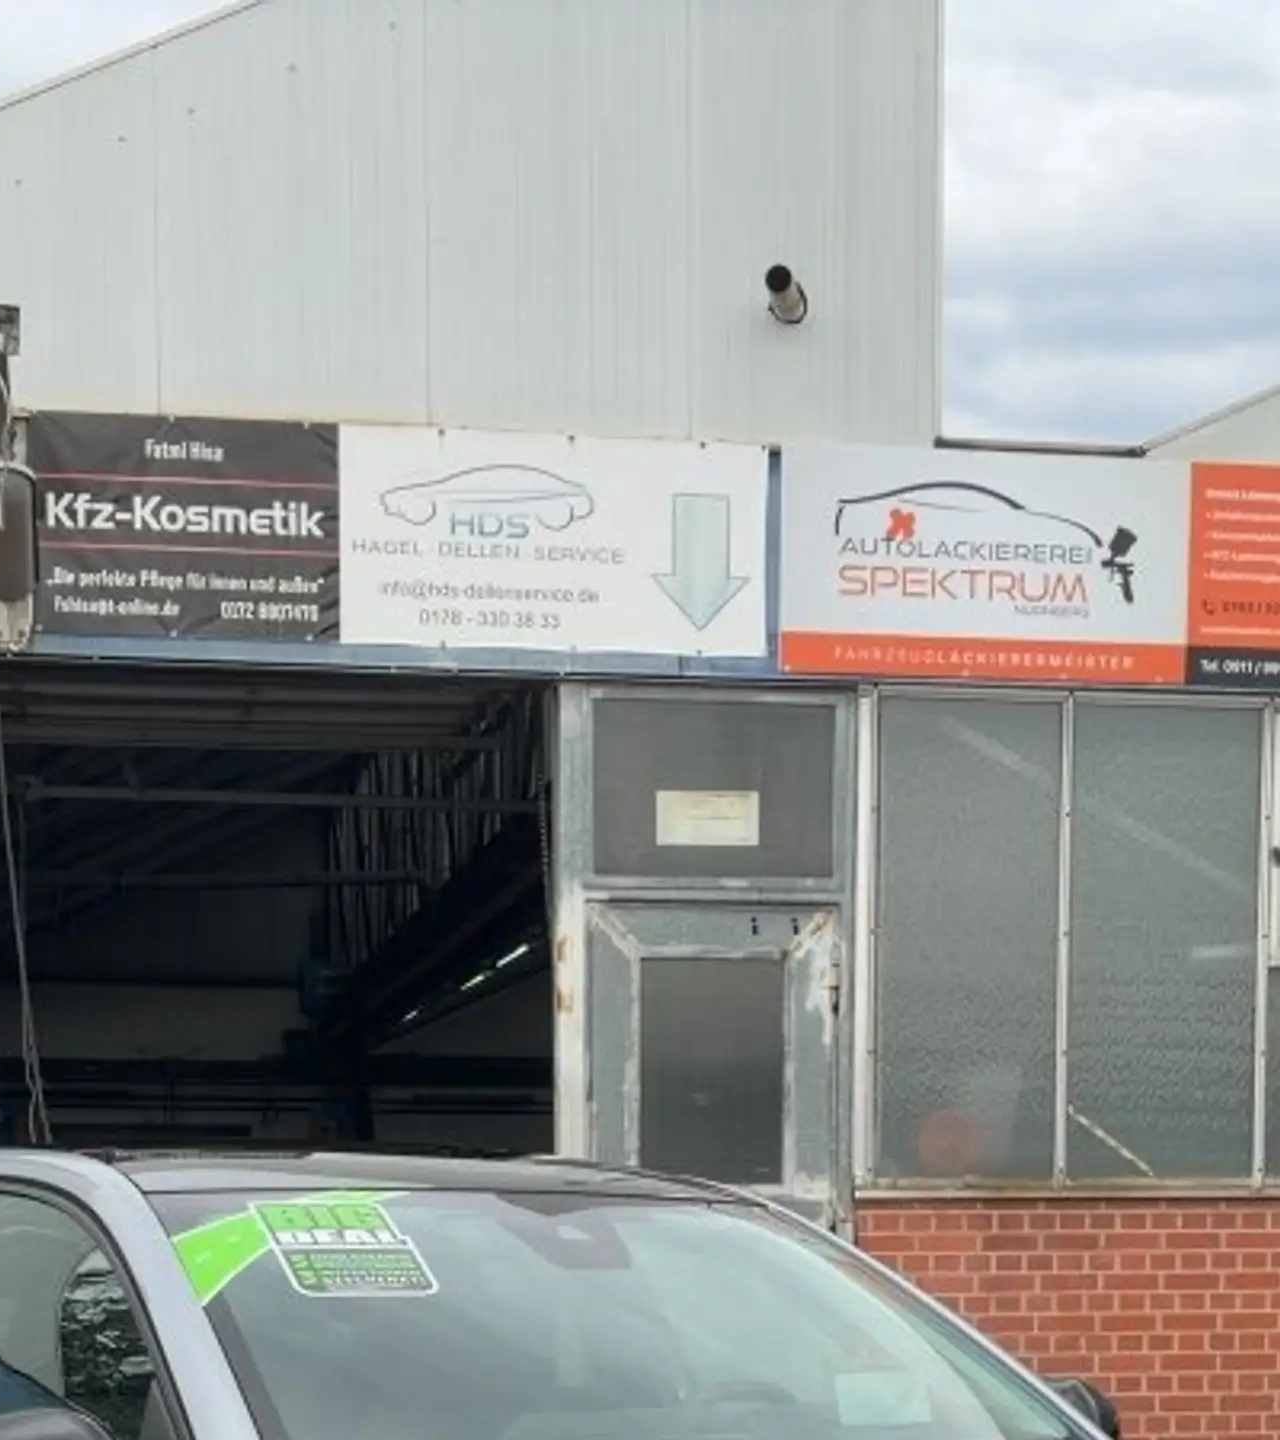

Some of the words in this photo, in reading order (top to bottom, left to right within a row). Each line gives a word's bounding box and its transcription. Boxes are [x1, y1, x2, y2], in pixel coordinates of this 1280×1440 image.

[45, 491, 325, 538] Kfz-Kosmetik
[449, 512, 531, 540] HDS
[351, 538, 422, 557] HAGEL
[438, 541, 520, 560] DELLEN
[534, 545, 625, 566] SERVICE
[838, 536, 1093, 565] AUTOLACKIEREREI
[80, 568, 137, 588] perfekte
[140, 568, 183, 592] Pflege
[186, 571, 206, 590] für
[208, 574, 247, 591] innen
[250, 576, 276, 593] und
[378, 580, 600, 605] info@hds-dellenservice.de
[838, 565, 1088, 604] SPEKTRUM
[419, 610, 461, 627] 0178
[834, 644, 1136, 671] FAHRZEUGLACKIERERMEISTER
